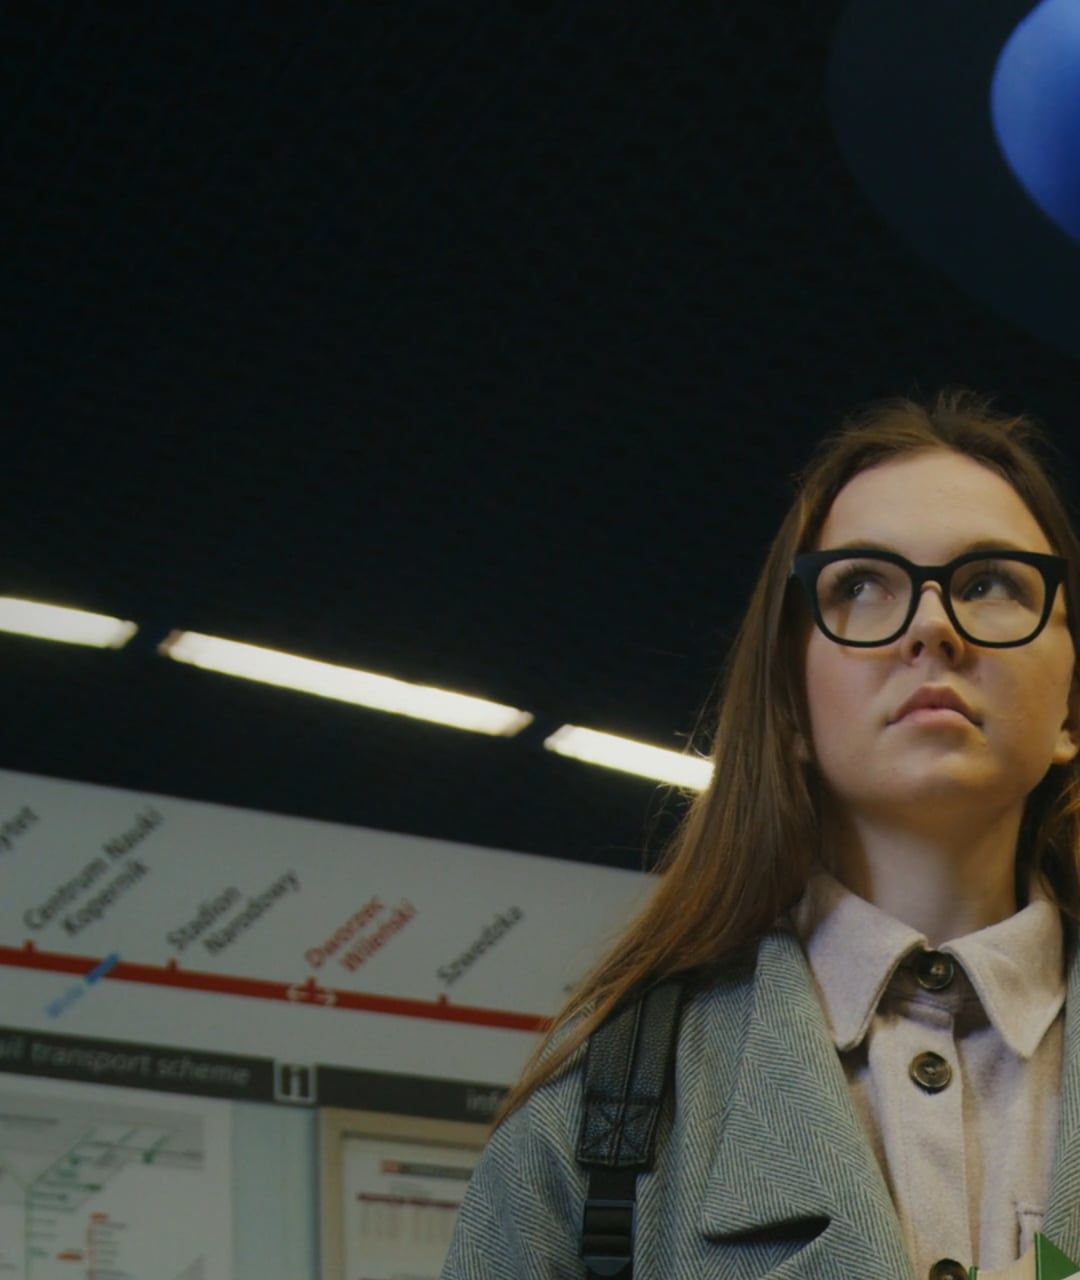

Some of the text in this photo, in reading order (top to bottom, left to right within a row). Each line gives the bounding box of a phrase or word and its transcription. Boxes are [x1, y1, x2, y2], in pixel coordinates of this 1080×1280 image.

[23, 806, 163, 931] Centrum Nauki
[62, 858, 150, 936] Kopernik
[166, 886, 241, 951] Stadion
[203, 868, 299, 955] Narodowy
[305, 896, 383, 967] Dworzec
[437, 906, 523, 985] Szwedzka
[31, 1042, 152, 1076] transport
[156, 1056, 250, 1085] scheme
